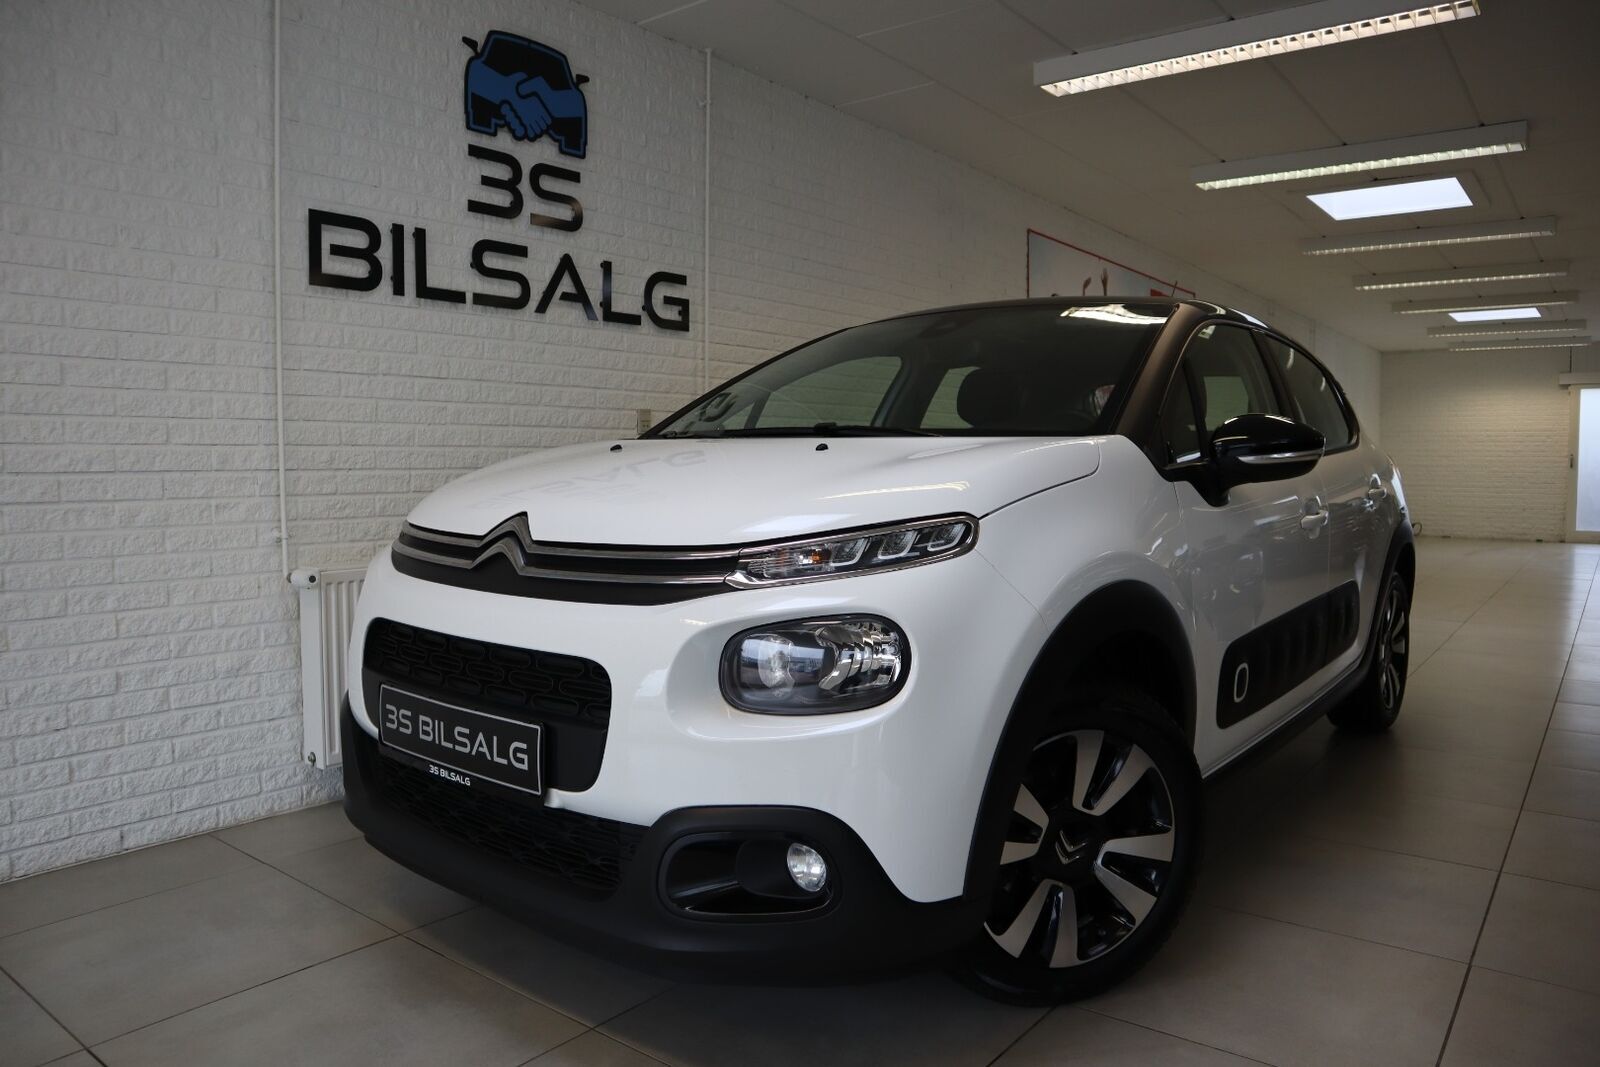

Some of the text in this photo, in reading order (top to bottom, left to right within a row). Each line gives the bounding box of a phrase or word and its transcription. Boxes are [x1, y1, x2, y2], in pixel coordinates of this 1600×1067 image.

[467, 143, 584, 232] 3S
[308, 208, 690, 332] BILSALG
[385, 703, 529, 771] 3S BILSALG
[429, 764, 471, 786] 3S BILSALG
